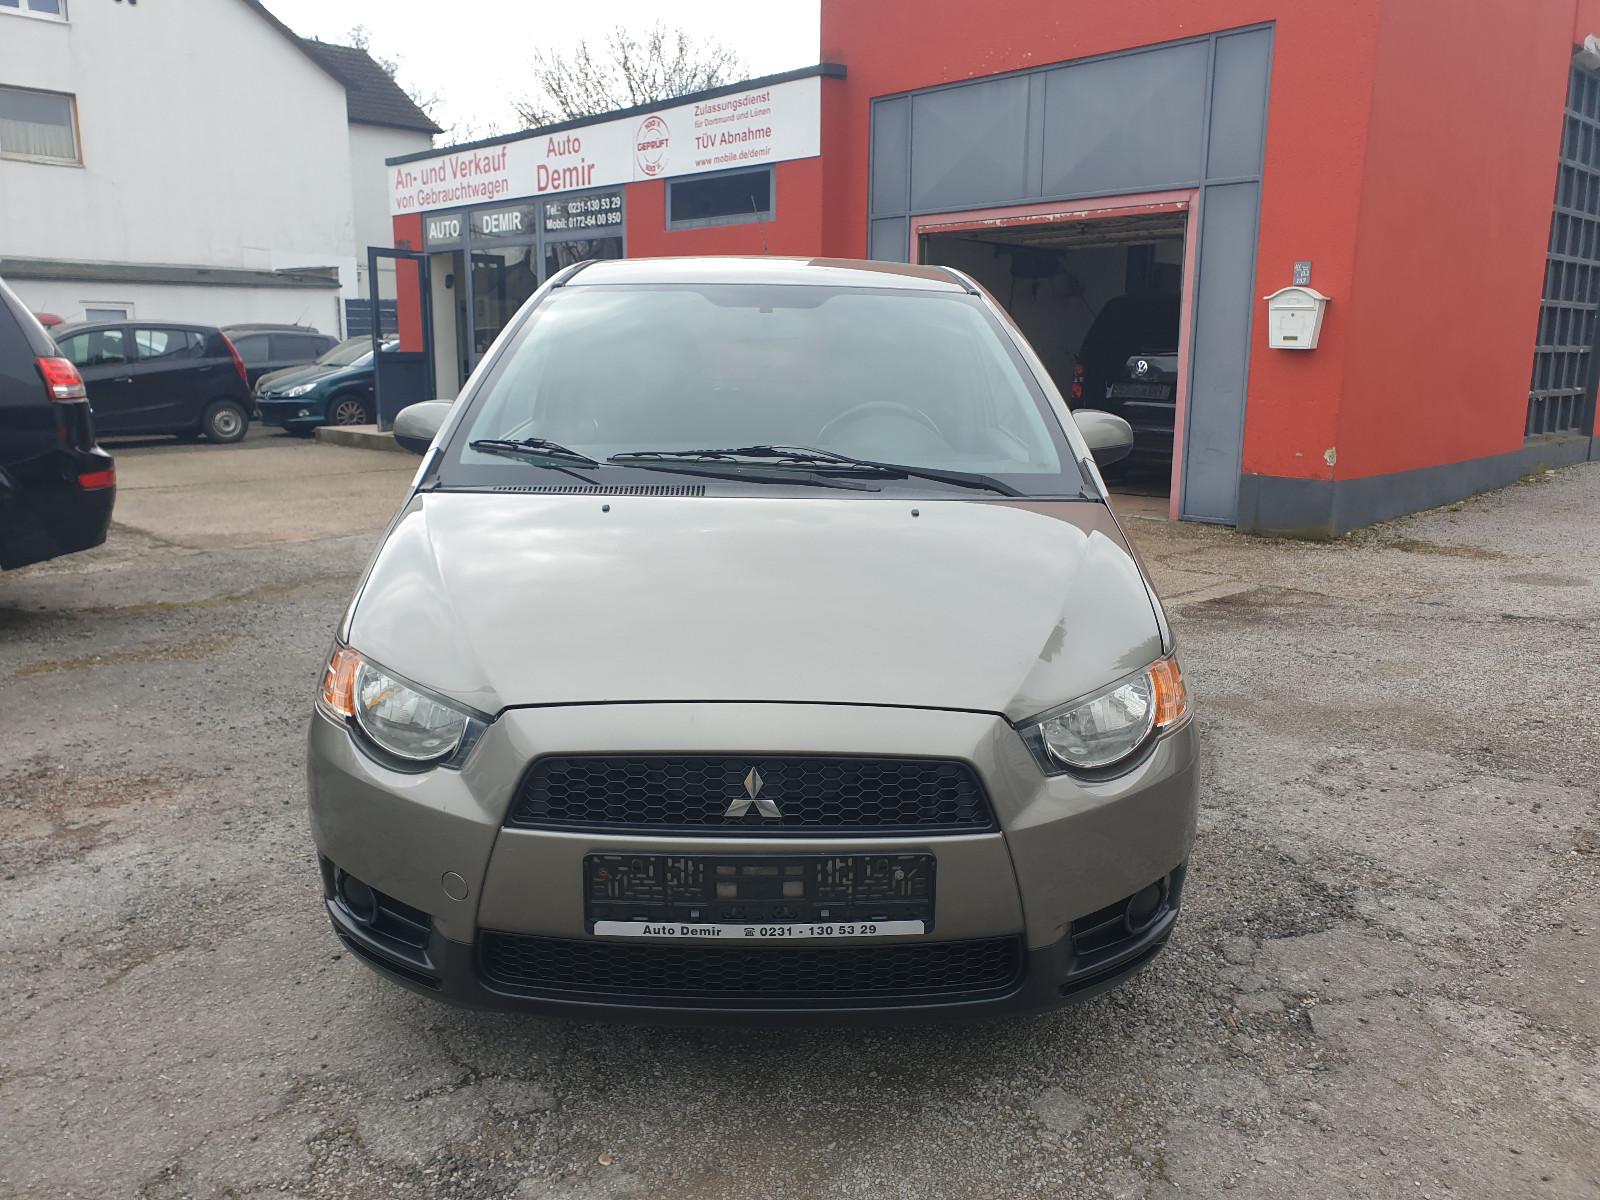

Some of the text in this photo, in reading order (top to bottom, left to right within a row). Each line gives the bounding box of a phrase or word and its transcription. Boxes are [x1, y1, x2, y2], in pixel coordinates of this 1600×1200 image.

[694, 91, 770, 116] Zulassungsdienst
[704, 113, 735, 127] Dortmund
[736, 111, 749, 120] und
[750, 108, 771, 118] Lünen
[547, 135, 581, 158] Auto
[637, 138, 669, 152] GEPRÜFT
[695, 127, 772, 150] TÜV Abnahme
[395, 146, 508, 190] An- und Verkauf
[536, 158, 595, 192] Demir
[395, 178, 509, 209] von Gebrauchtwagen
[568, 199, 599, 214] 0231-130
[601, 198, 610, 210] 53
[611, 196, 621, 208] 29
[429, 211, 522, 240] AUTO DEMIR
[546, 211, 621, 230] Mobil: 0172-64 00 950
[643, 925, 676, 936] Auto
[680, 925, 722, 937] Demir
[759, 925, 793, 937] 0231
[808, 925, 835, 937] 130
[838, 924, 857, 936] 53
[860, 924, 878, 936] 29
